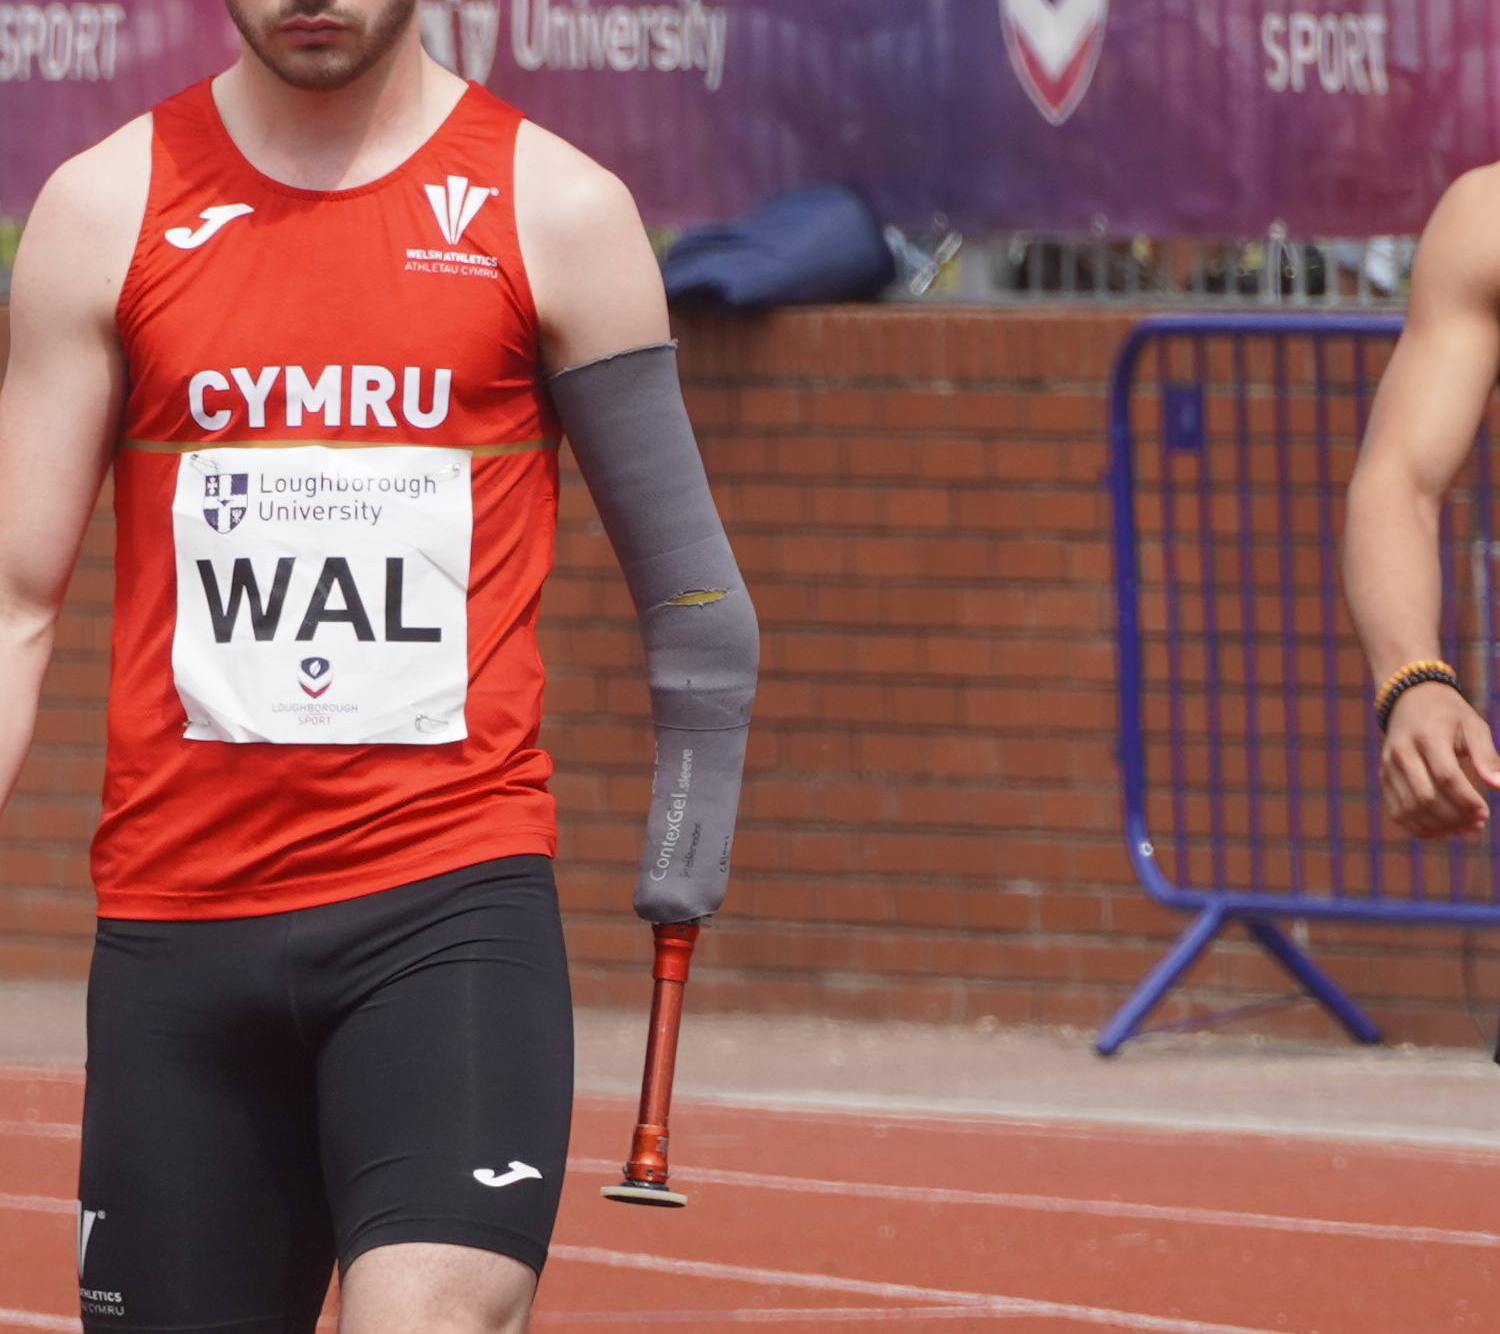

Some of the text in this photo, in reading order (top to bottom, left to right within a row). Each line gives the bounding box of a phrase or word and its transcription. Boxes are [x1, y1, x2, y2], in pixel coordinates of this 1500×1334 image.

[1261, 11, 1389, 95] SPORT
[404, 261, 499, 279] ATHLETAU CYMRU
[405, 249, 498, 267] WELSH ATHLETICS
[188, 365, 452, 432] CYMRU
[260, 472, 437, 498] Loughborough
[258, 501, 383, 526] University
[196, 557, 442, 644] WAL
[271, 703, 359, 713] LOUGHBOROUGH
[297, 716, 332, 726] SPORT
